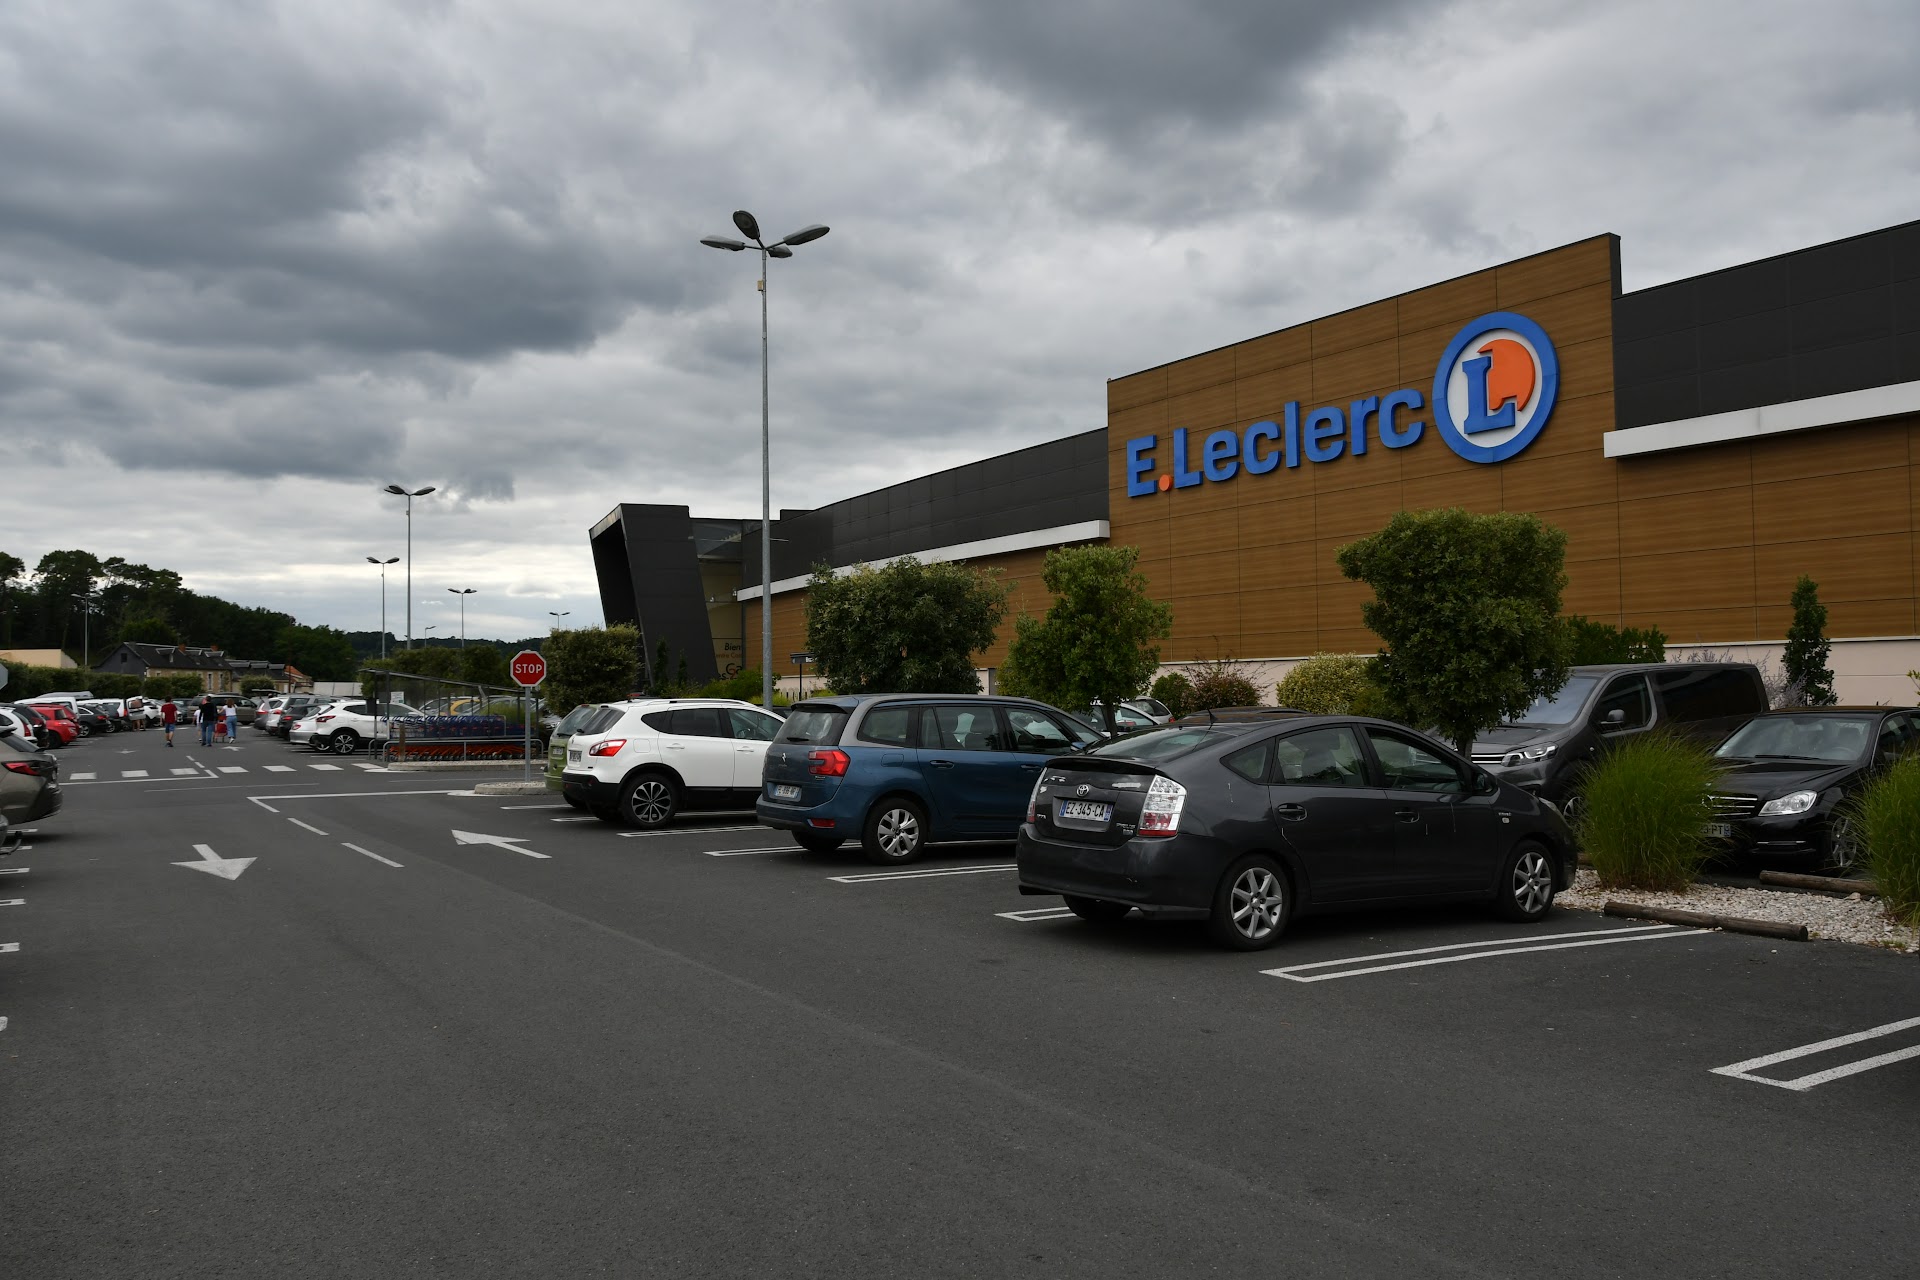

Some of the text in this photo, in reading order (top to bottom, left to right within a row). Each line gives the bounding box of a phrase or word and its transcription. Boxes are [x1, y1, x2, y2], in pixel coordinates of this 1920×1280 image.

[1126, 388, 1425, 497] E.Leclerc
[515, 663, 543, 674] STOP
[1066, 802, 1104, 818] EZ-345-CA
